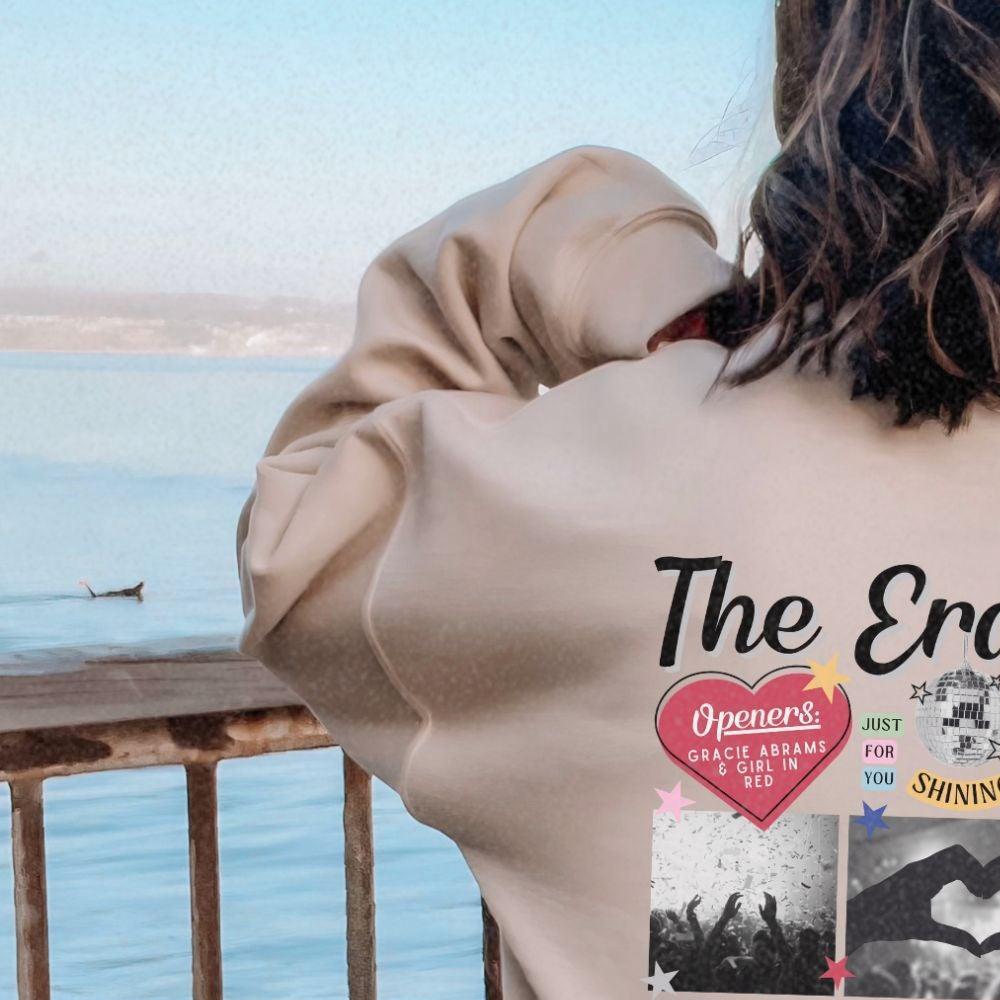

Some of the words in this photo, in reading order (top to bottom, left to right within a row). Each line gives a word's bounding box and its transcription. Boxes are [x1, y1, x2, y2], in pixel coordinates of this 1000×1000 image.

[655, 555, 823, 668] The
[692, 701, 821, 742] Openers:
[861, 718, 902, 732] JUST
[688, 745, 751, 763] GRACIE
[760, 740, 827, 757] ABRAMS
[865, 745, 895, 759] FOR
[718, 762, 727, 776] &
[736, 760, 774, 774] GIRL
[783, 758, 799, 771] IN
[744, 775, 774, 789] RED
[864, 772, 894, 786] YOU
